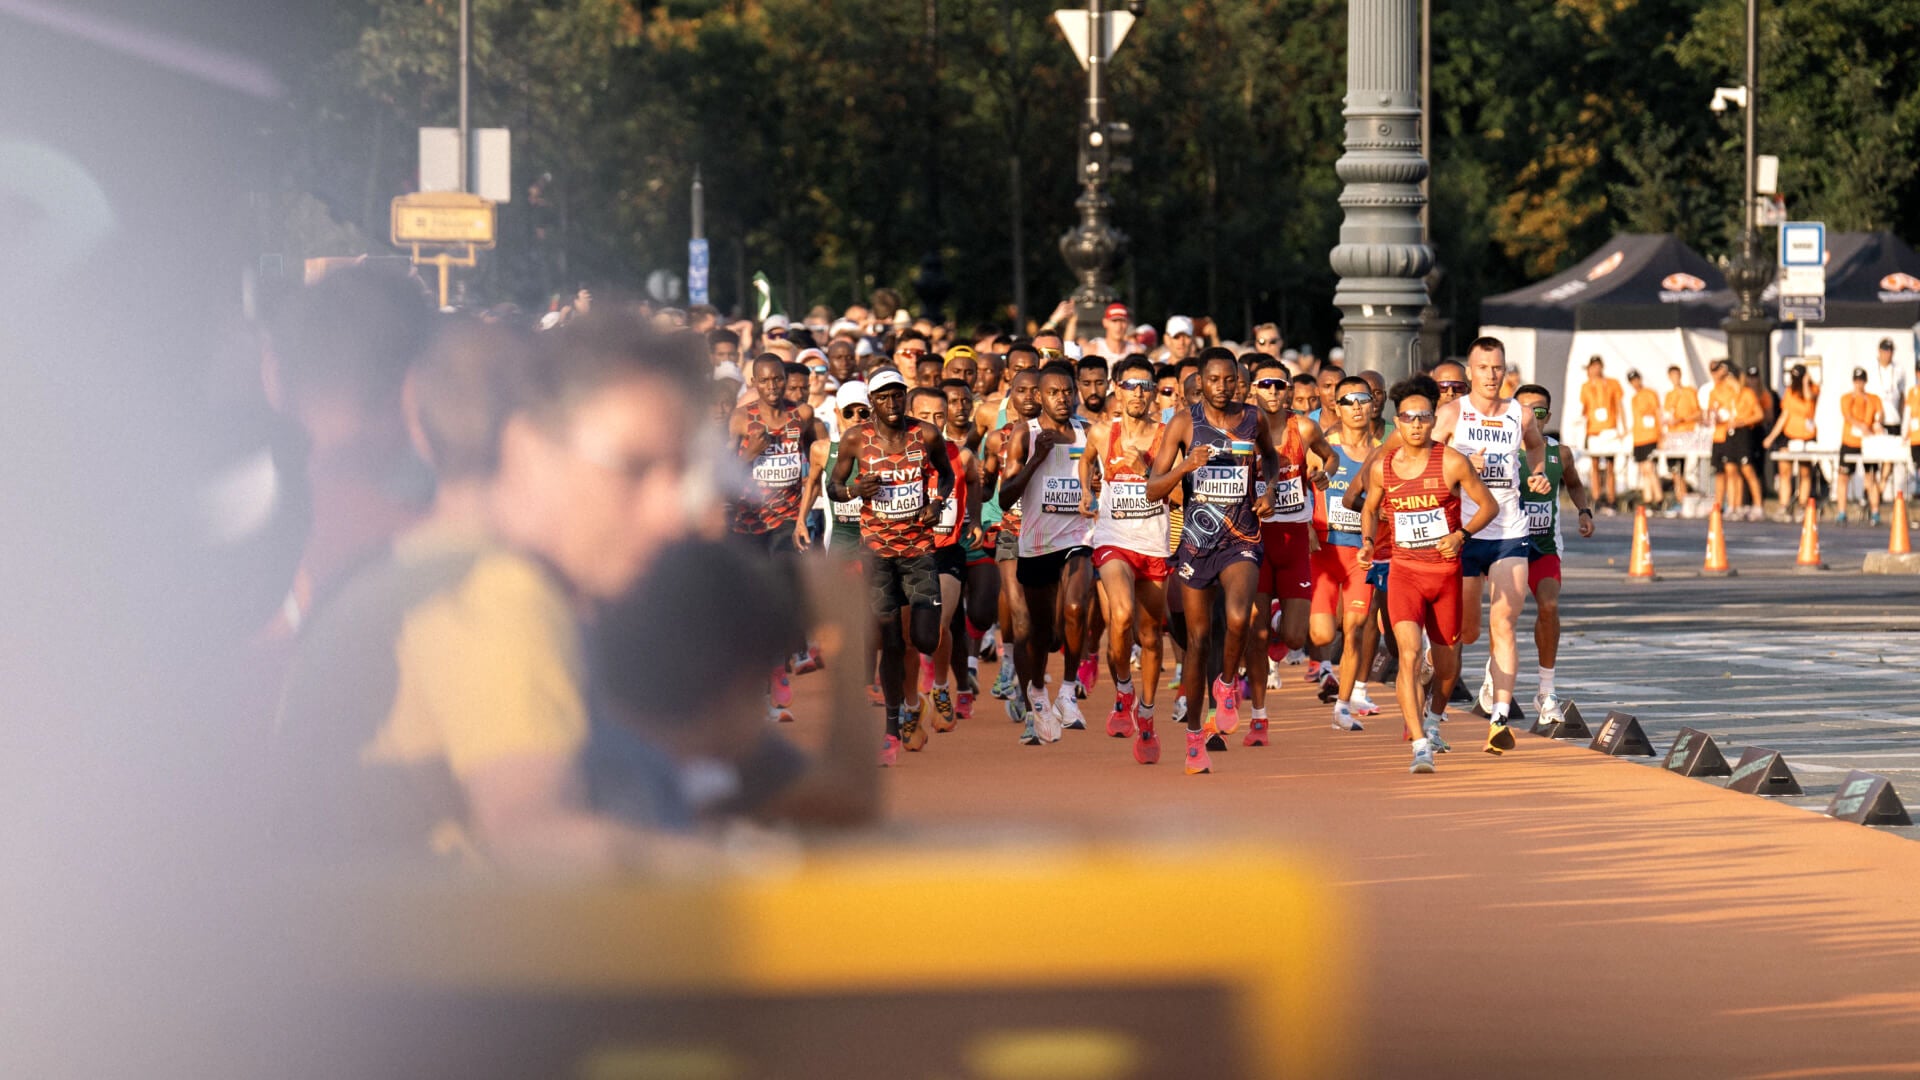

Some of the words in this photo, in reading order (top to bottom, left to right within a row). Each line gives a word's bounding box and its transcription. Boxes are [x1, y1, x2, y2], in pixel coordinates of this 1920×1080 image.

[1468, 427, 1513, 444] NORWAY
[768, 455, 798, 467] TDK
[756, 466, 799, 479] KIPRUTO
[1208, 467, 1244, 480] TDK
[884, 483, 919, 498] TDK
[1058, 478, 1083, 489] TD
[1123, 484, 1148, 495] TD
[1196, 479, 1245, 494] MUHITIRA
[1277, 479, 1300, 493] DK
[873, 495, 921, 511] KIPLAGAT
[1390, 494, 1440, 510] CHINA
[1405, 510, 1442, 526] TDK
[1529, 515, 1550, 528] ILLO
[1412, 526, 1430, 540] HE
